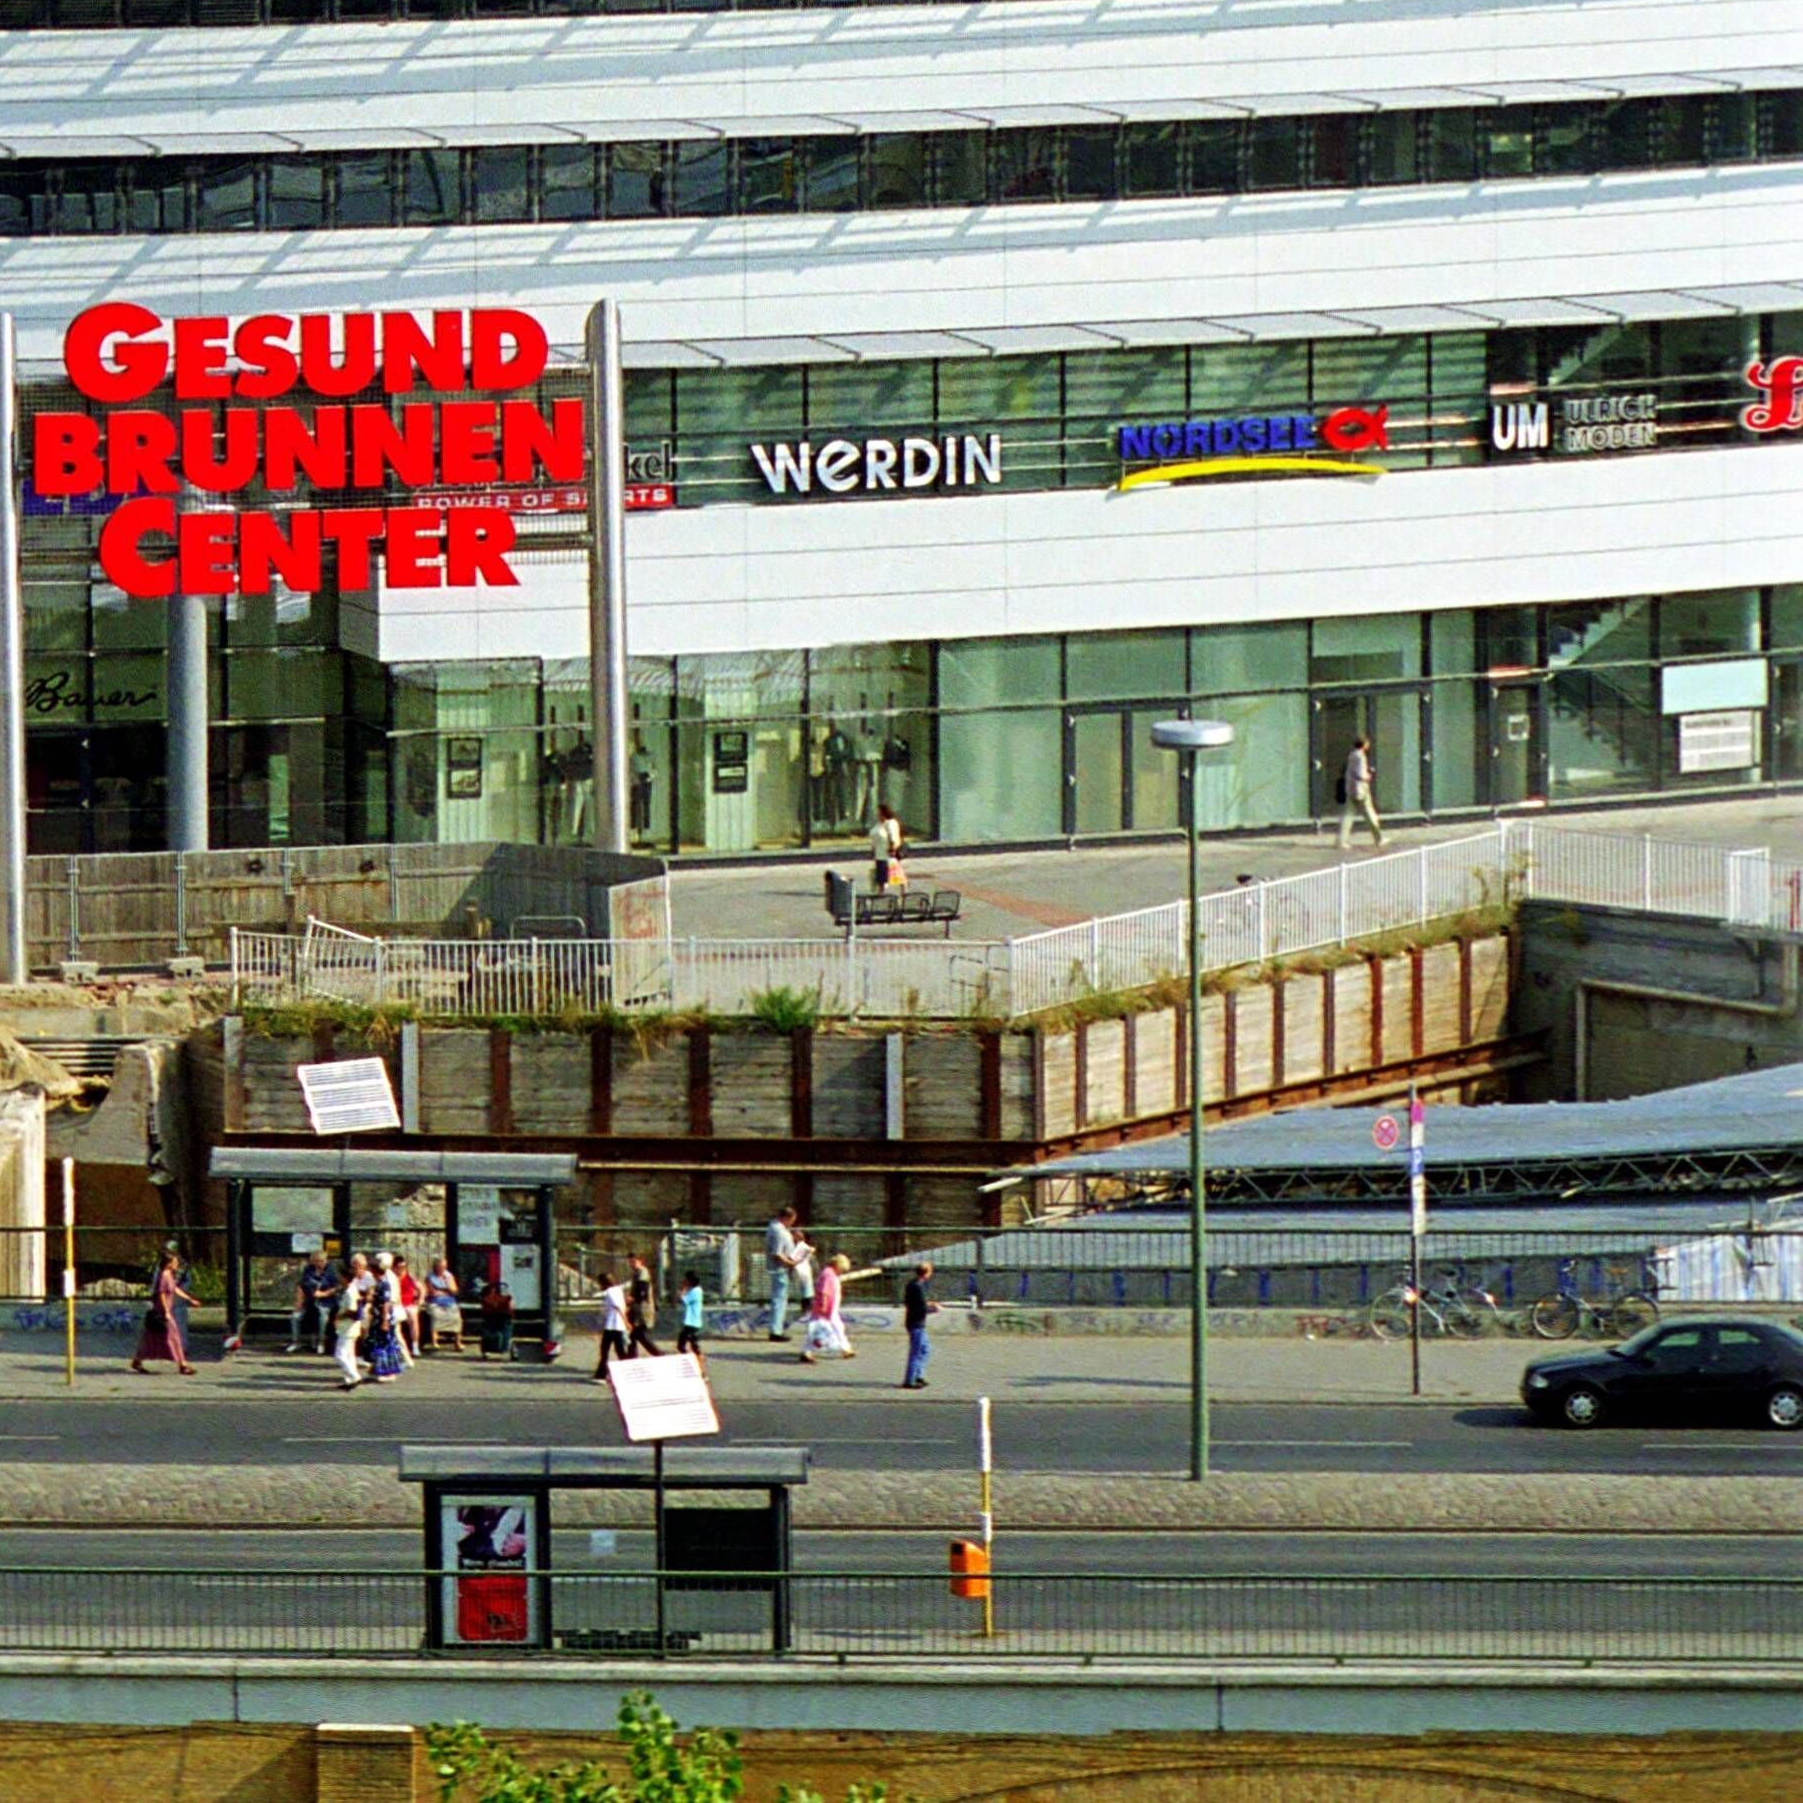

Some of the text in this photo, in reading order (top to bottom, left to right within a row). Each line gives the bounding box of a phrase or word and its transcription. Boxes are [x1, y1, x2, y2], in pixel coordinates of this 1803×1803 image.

[64, 302, 548, 400] GESUND
[1493, 402, 1550, 451] UM
[1565, 394, 1657, 423] ULRICH
[33, 400, 585, 496] BRUNNEN
[1118, 413, 1316, 460] NORDSEE
[1565, 422, 1658, 452] MODEN
[415, 494, 511, 511] POWER
[521, 492, 555, 507] OF
[99, 497, 520, 597] CENTER
